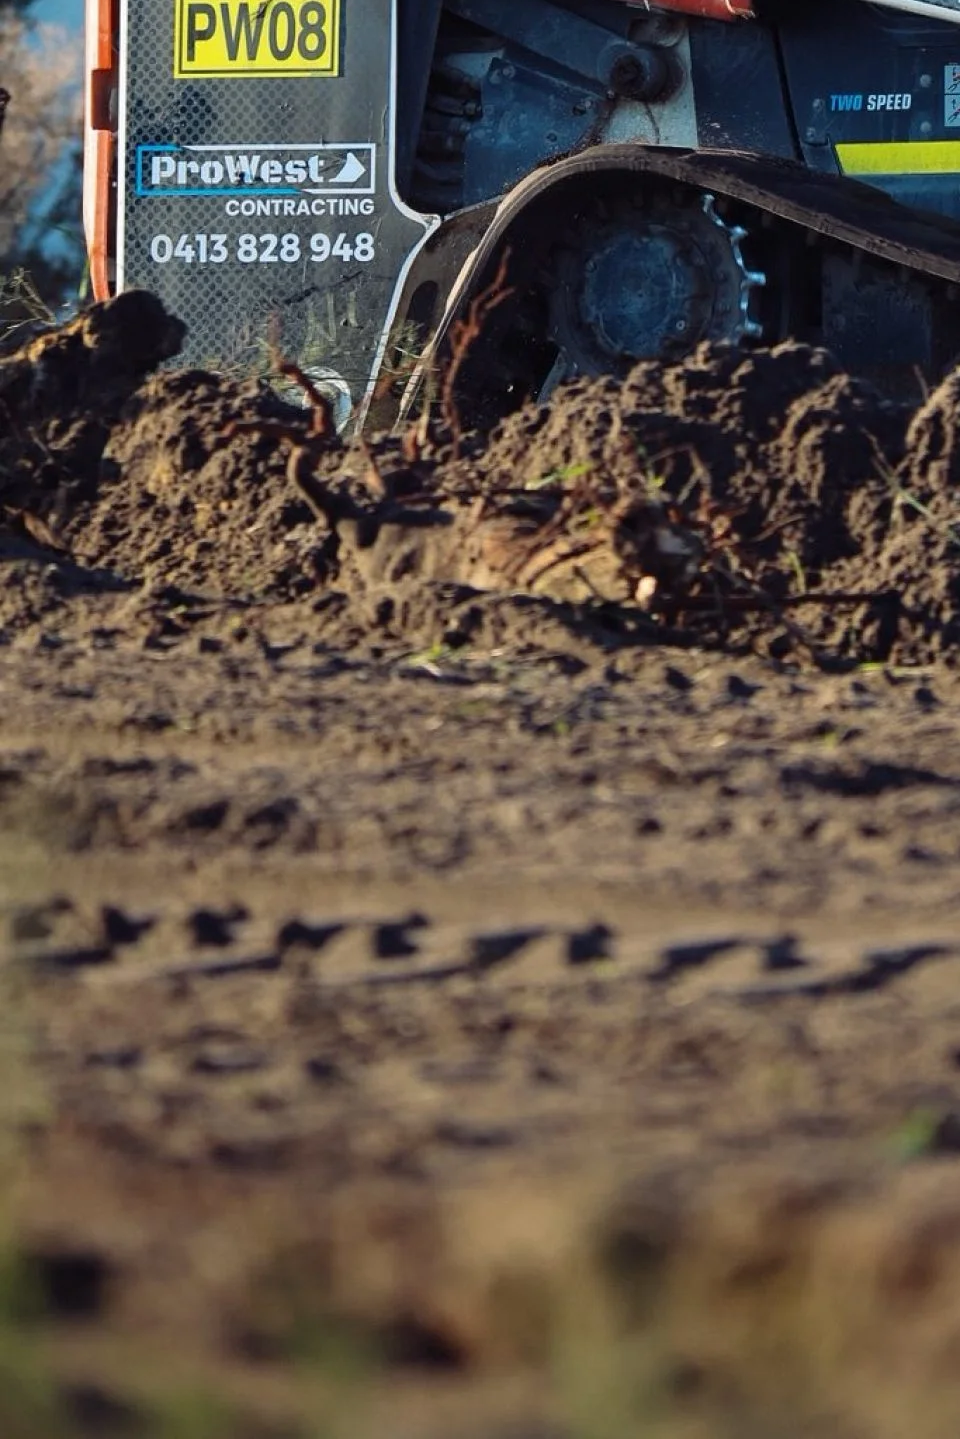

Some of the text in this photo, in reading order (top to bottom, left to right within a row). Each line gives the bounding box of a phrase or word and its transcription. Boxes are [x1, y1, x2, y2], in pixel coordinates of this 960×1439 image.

[187, 0, 326, 61] PW08
[830, 93, 912, 111] TWO SPEED
[151, 155, 325, 185] ProWest
[225, 199, 375, 216] CONTRACTING
[151, 233, 375, 263] 0413 828 948
